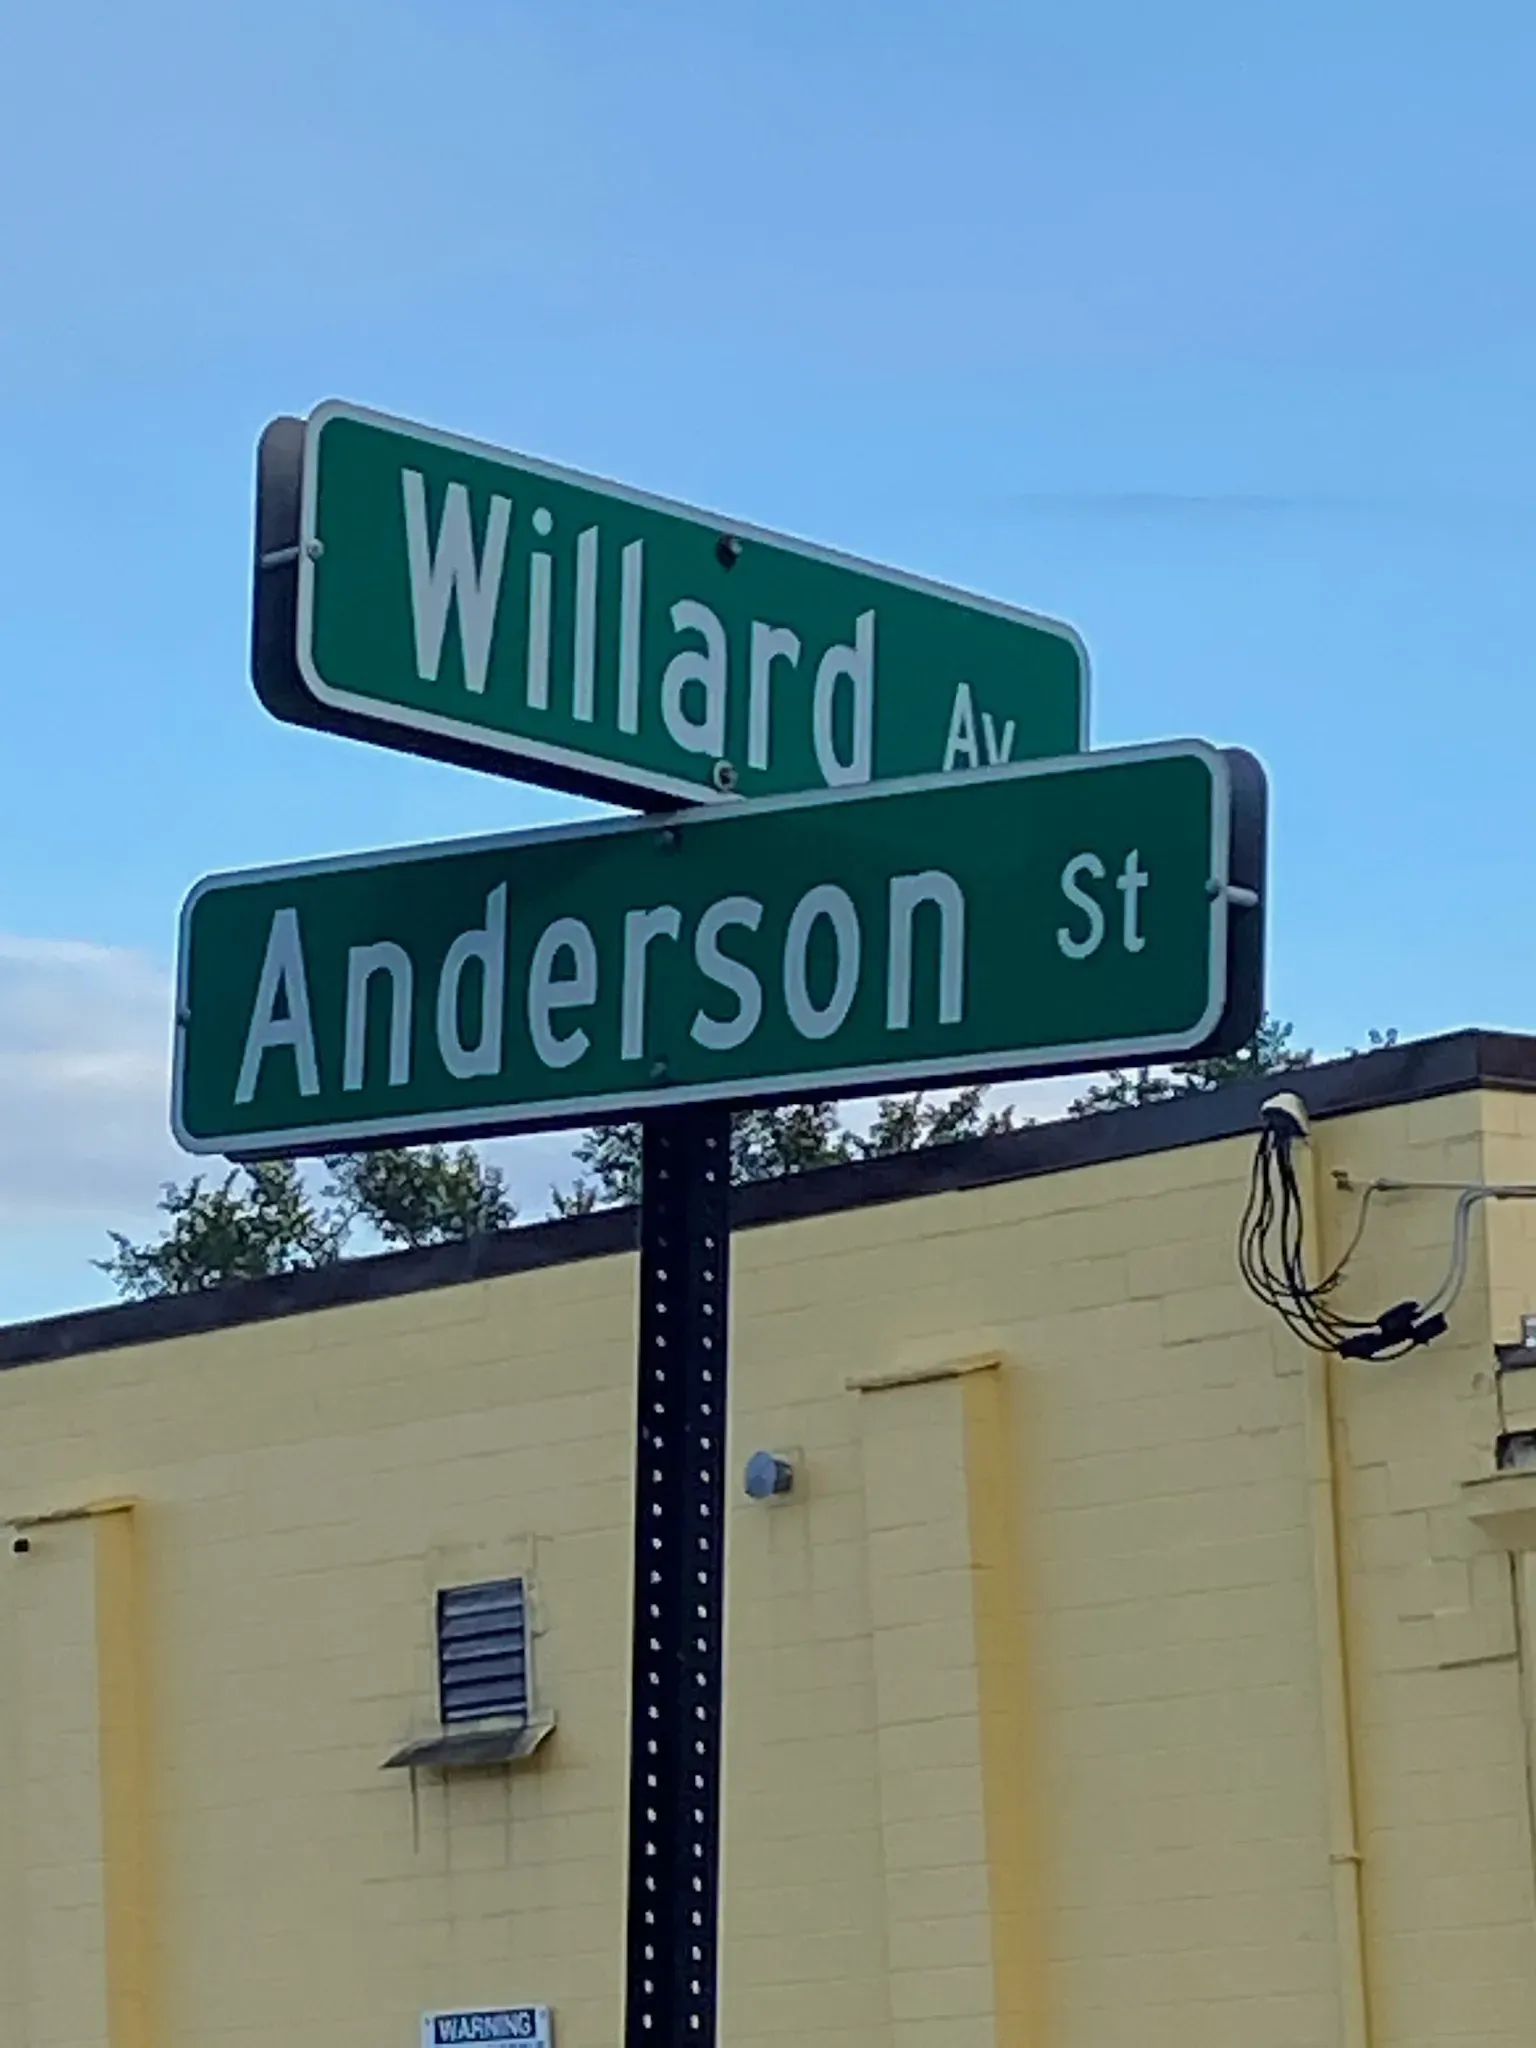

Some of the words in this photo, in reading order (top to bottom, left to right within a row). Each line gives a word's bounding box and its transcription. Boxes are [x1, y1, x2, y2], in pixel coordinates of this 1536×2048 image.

[401, 467, 875, 788] Willard
[942, 682, 1016, 771] Av
[233, 869, 966, 1106] Anderson
[1056, 848, 1149, 960] St
[437, 2011, 533, 2042] WARNING
